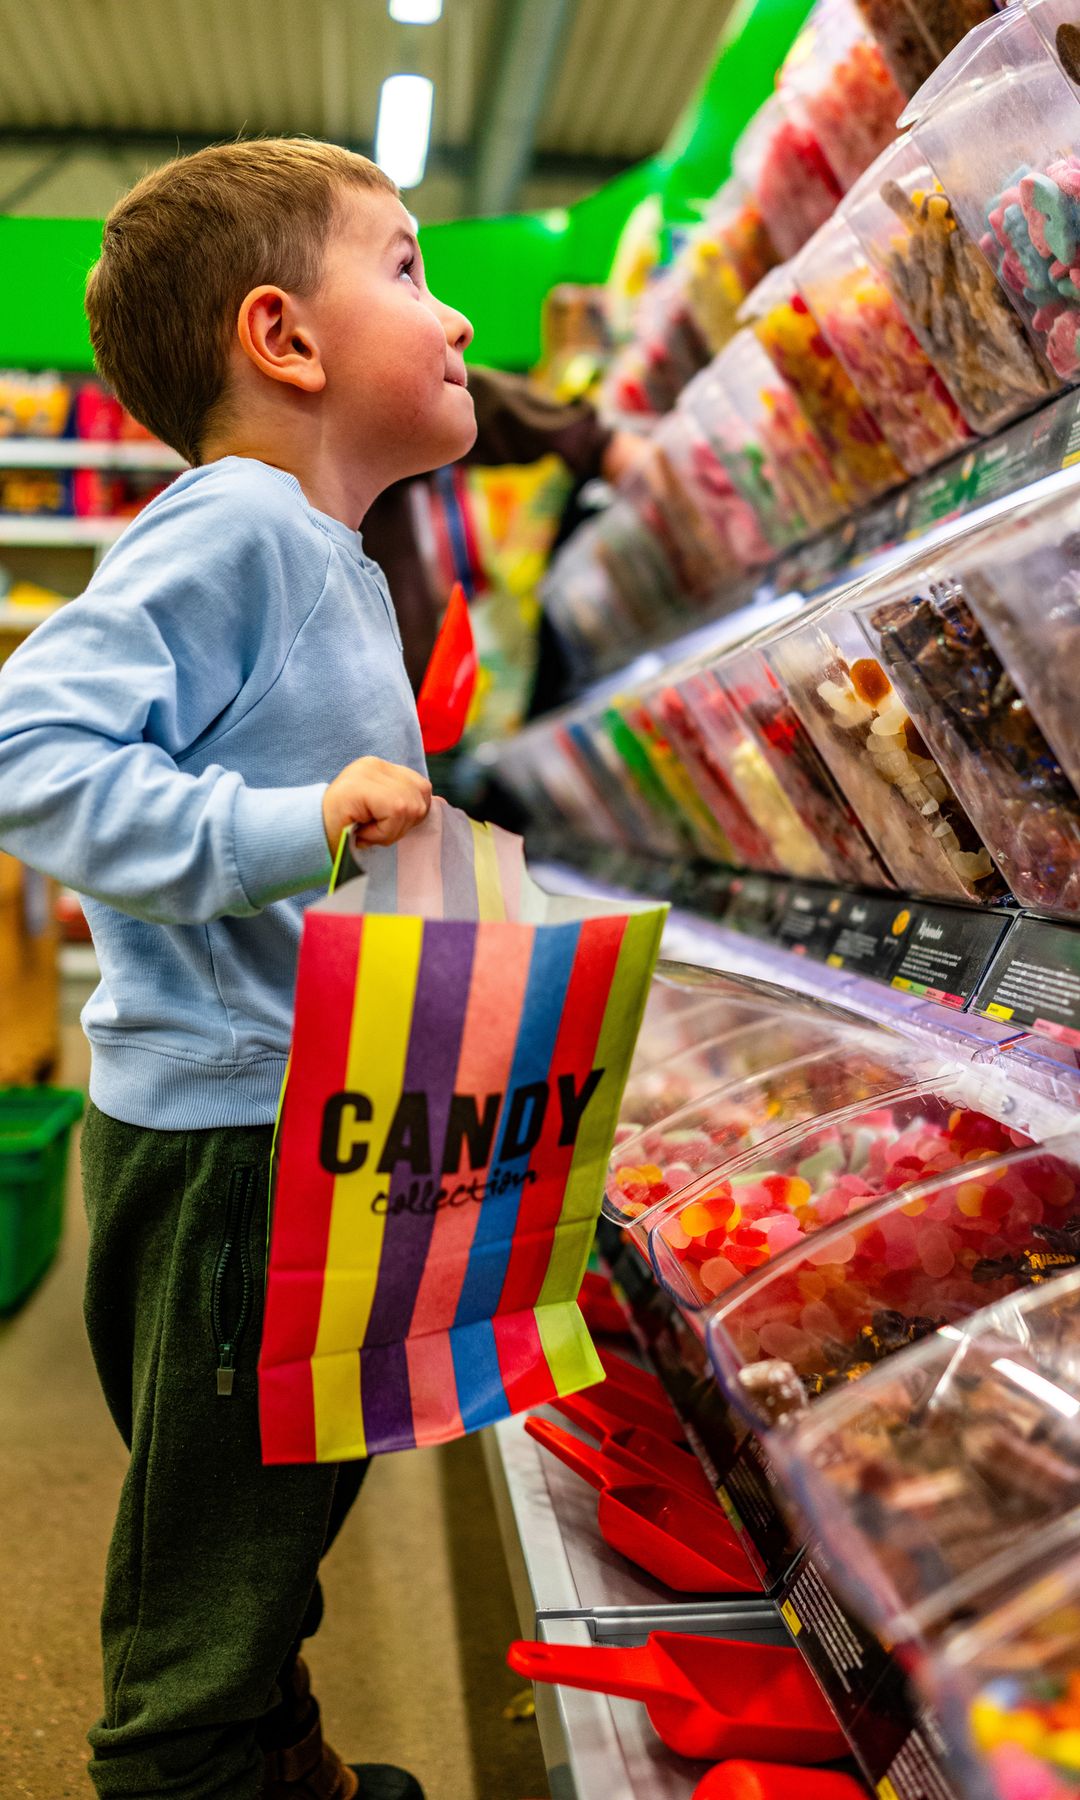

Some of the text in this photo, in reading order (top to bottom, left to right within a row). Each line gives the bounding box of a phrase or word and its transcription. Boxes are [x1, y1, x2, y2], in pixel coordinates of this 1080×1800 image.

[318, 1067, 606, 1176] CANDY
[370, 1167, 538, 1217] collection
[1028, 1253, 1076, 1270] RIESEN
